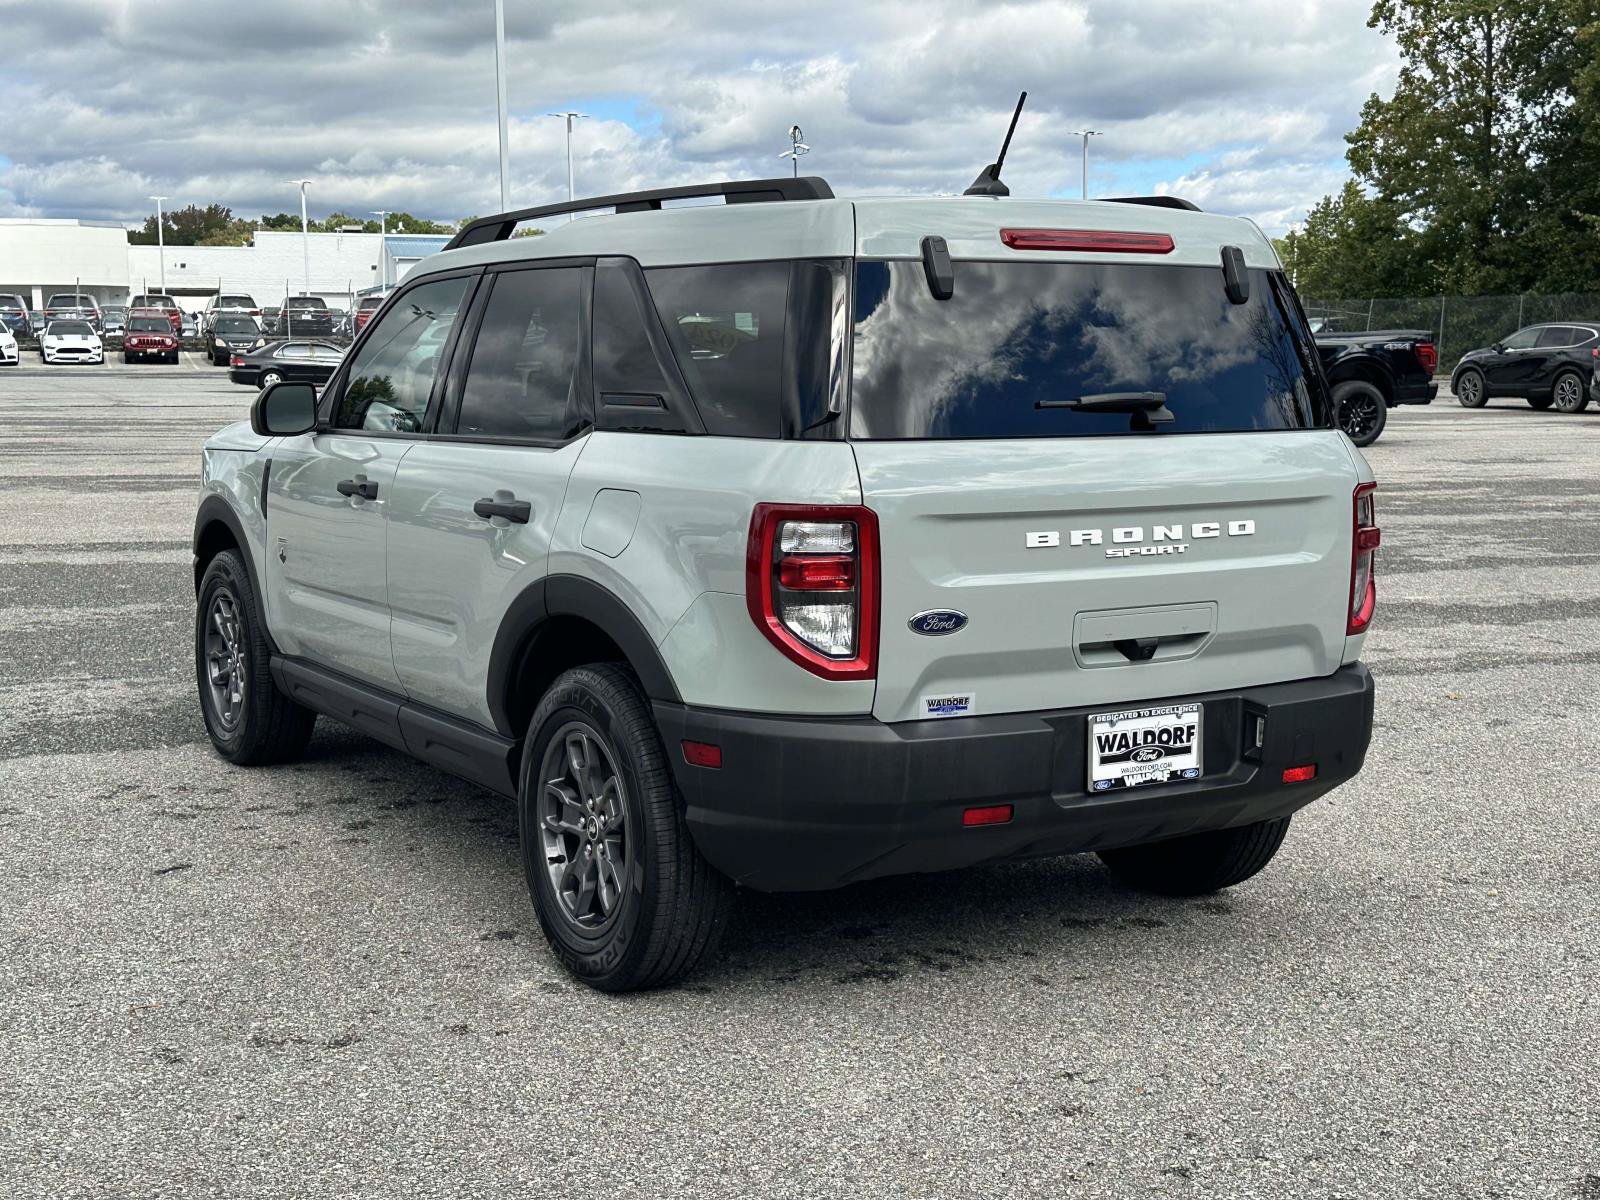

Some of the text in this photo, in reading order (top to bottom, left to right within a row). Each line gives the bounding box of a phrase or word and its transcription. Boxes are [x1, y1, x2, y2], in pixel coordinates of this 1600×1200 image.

[1025, 519, 1256, 548] BRONCO
[1105, 544, 1189, 558] SPORT
[923, 614, 956, 631] Ford
[926, 697, 970, 708] WALDORF
[1096, 704, 1198, 723] DEDICATED TO EXCELLENCE
[1096, 725, 1196, 754] WALDORF
[1136, 749, 1158, 762] Ford
[1123, 769, 1171, 787] WALDORF
